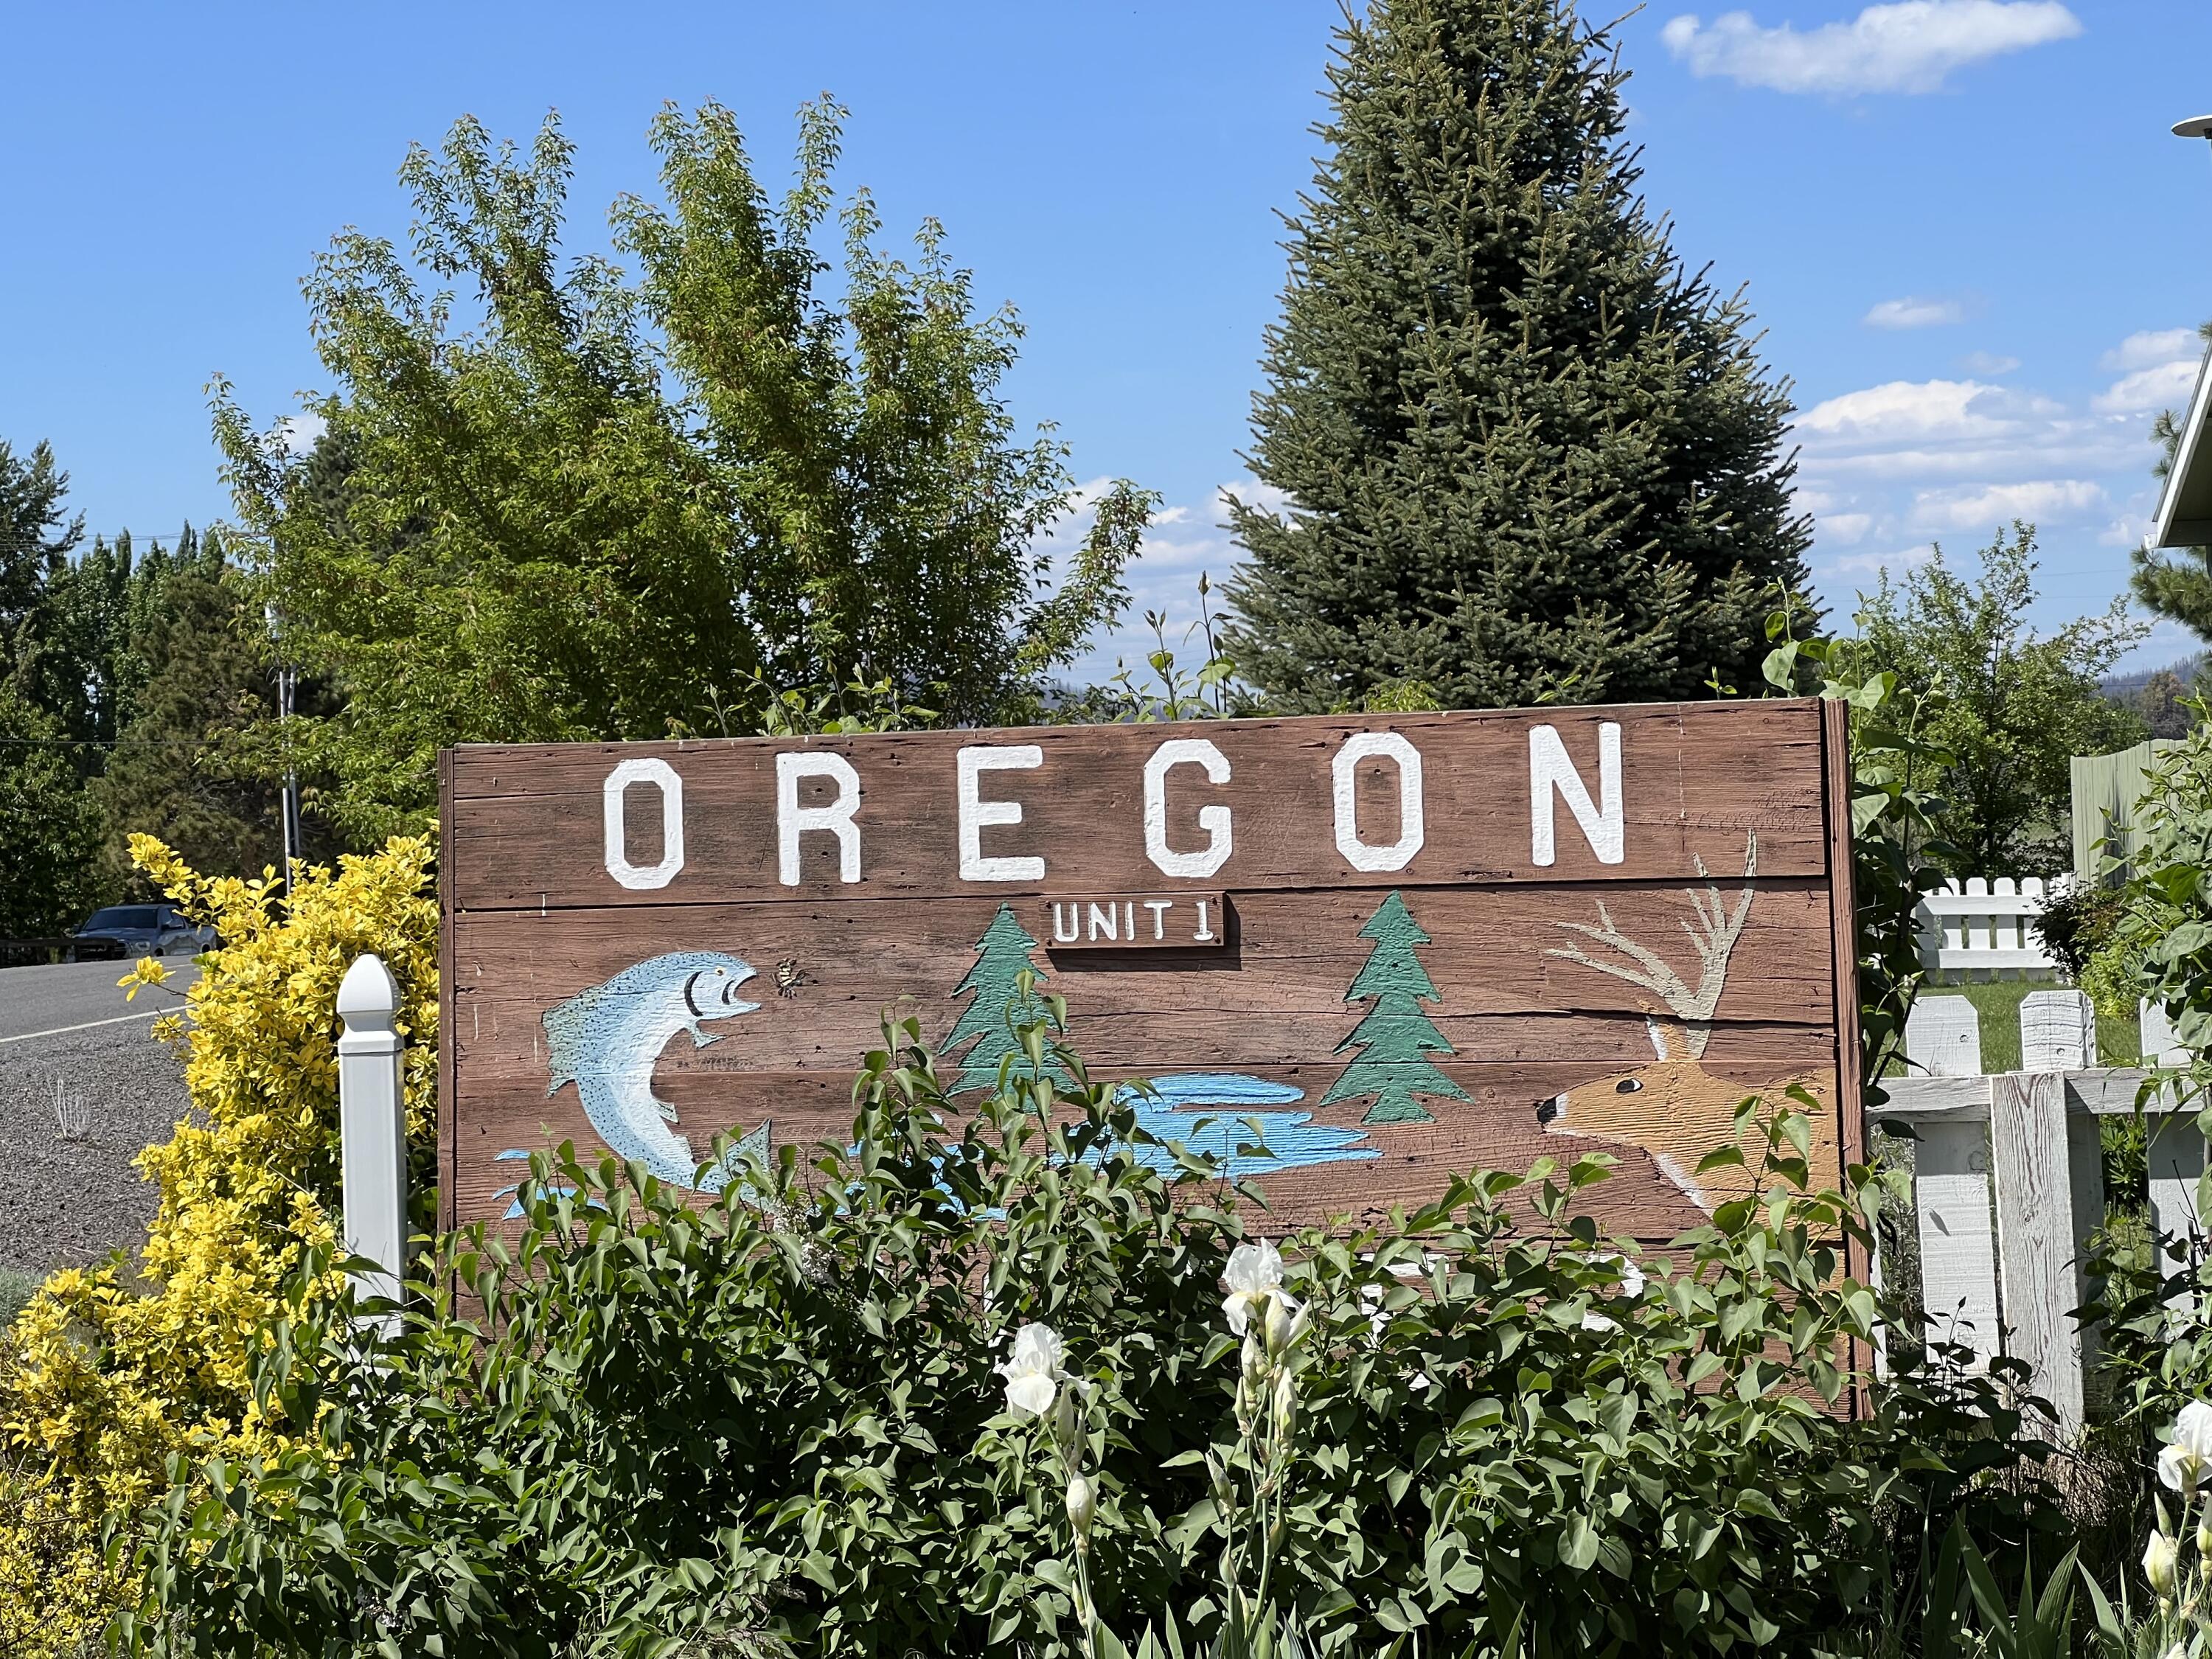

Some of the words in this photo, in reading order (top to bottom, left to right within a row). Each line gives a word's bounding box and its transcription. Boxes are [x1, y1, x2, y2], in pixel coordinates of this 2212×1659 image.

[603, 722, 1626, 890] OREGON
[1054, 900, 1173, 942] UNIT
[1193, 900, 1214, 941] 1
